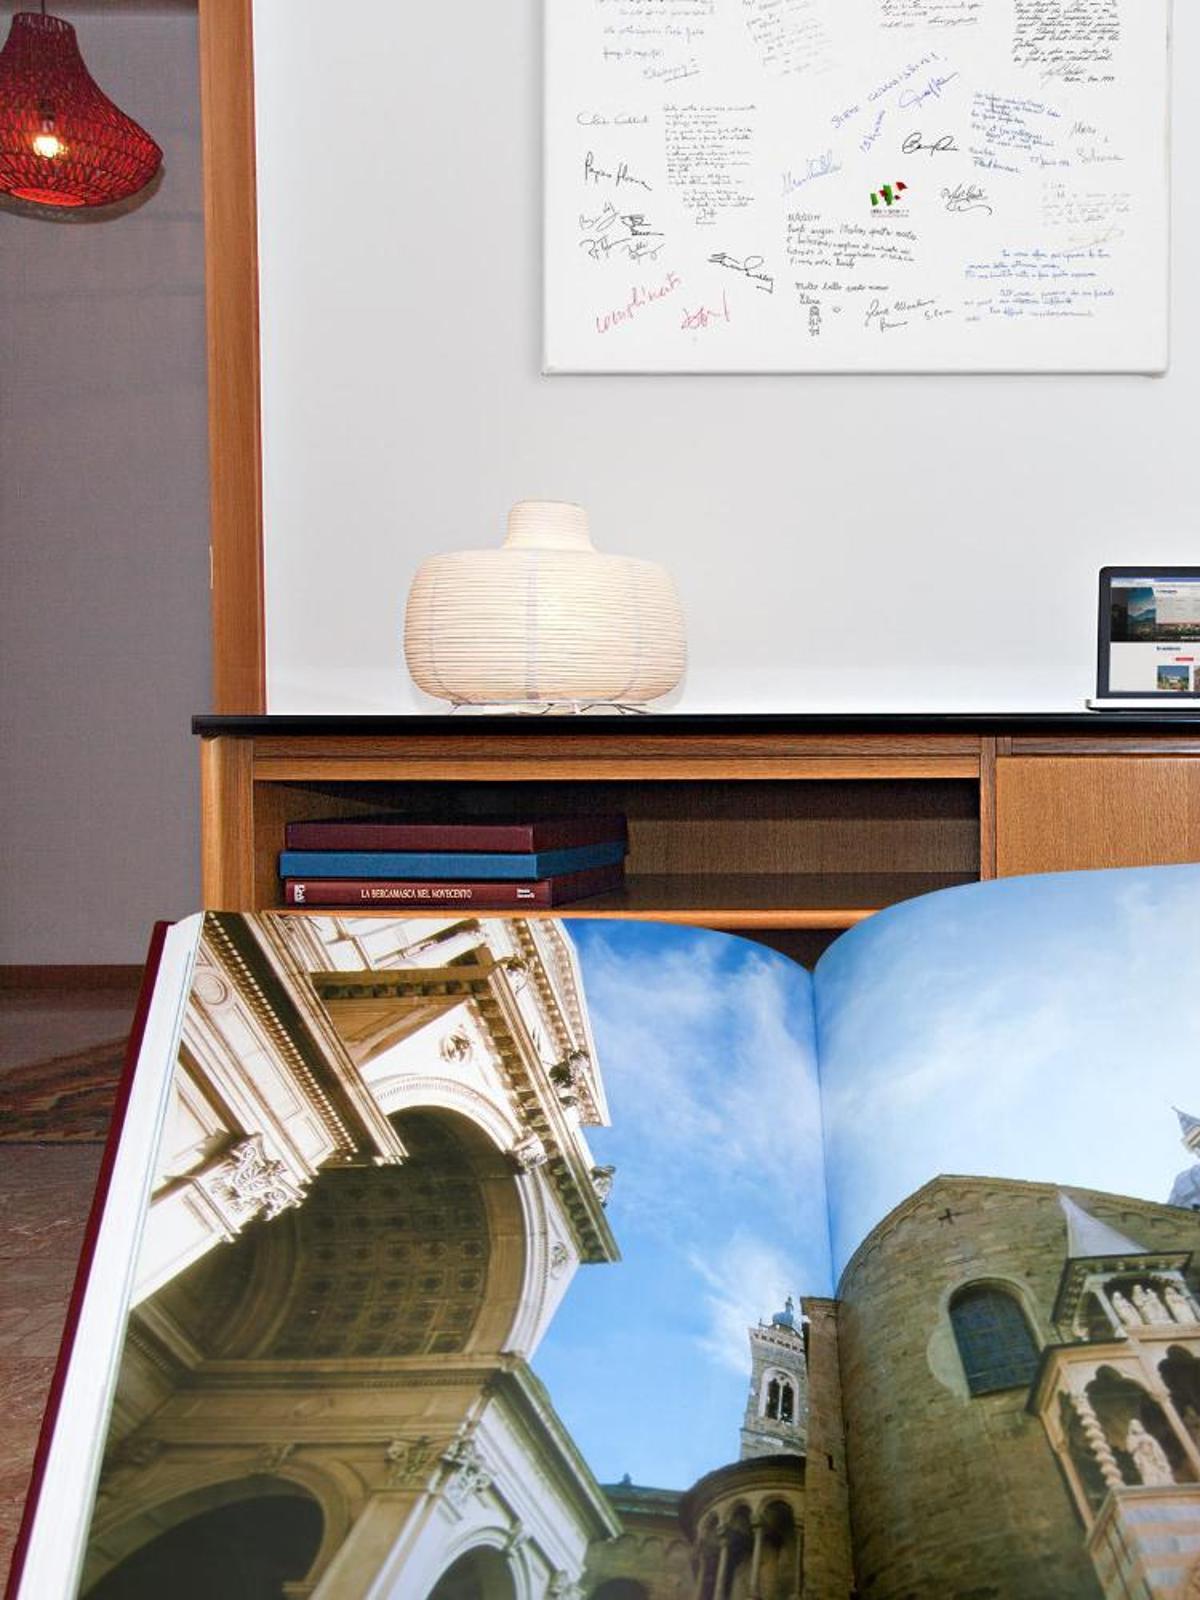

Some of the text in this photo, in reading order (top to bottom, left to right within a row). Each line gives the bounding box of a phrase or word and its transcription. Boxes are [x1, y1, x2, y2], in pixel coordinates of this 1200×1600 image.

[361, 888, 472, 899] LA BERGAMASCA NEL NOVECENTO
